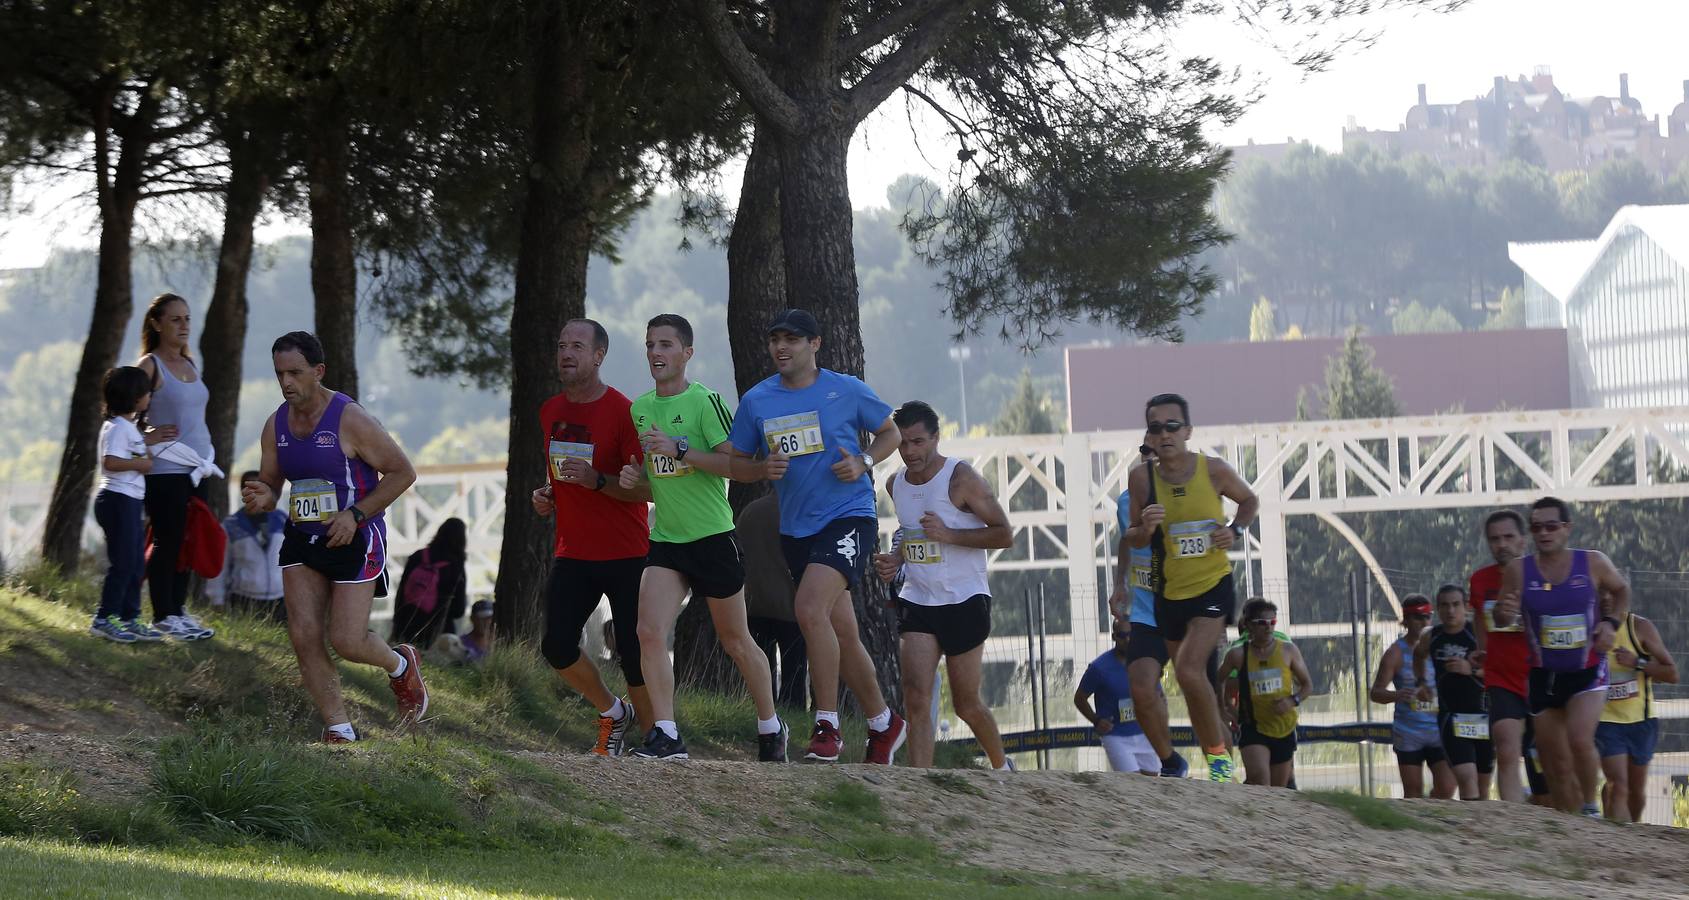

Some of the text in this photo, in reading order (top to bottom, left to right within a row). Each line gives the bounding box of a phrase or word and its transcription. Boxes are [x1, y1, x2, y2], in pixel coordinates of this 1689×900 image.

[780, 434, 798, 454] 66
[653, 456, 675, 474] 128
[296, 498, 319, 517] 204
[906, 545, 924, 560] 173
[1180, 538, 1205, 555] 238
[1550, 631, 1573, 646] 340
[1460, 725, 1478, 737] 326
